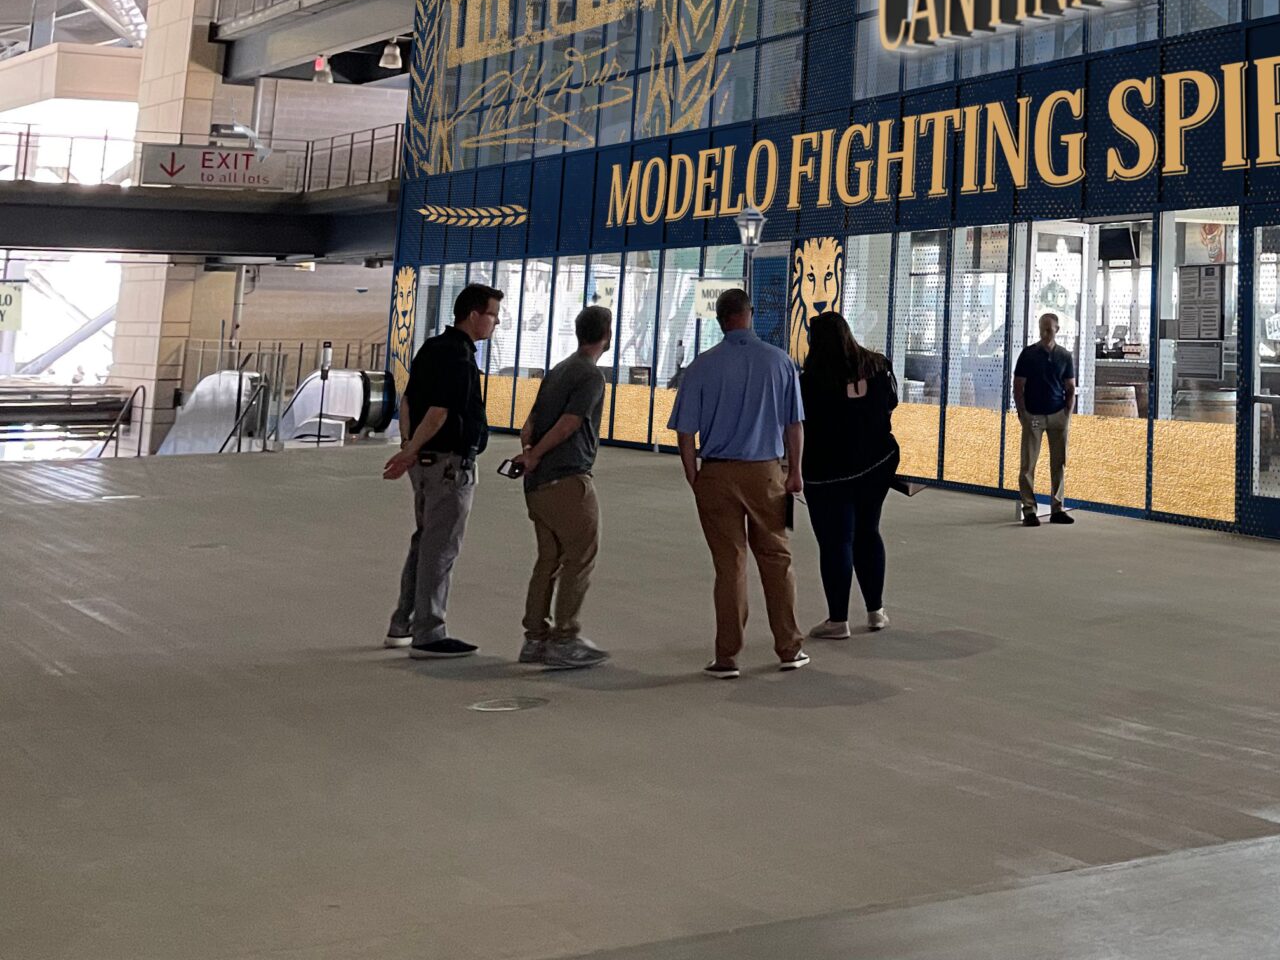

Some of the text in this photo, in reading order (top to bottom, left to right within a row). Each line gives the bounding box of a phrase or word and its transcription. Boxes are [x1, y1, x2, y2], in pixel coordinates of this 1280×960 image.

[201, 151, 255, 170] EXIT
[605, 139, 779, 229] MODELO
[786, 87, 1087, 213] FIGHTING
[200, 172, 270, 184] to all lots
